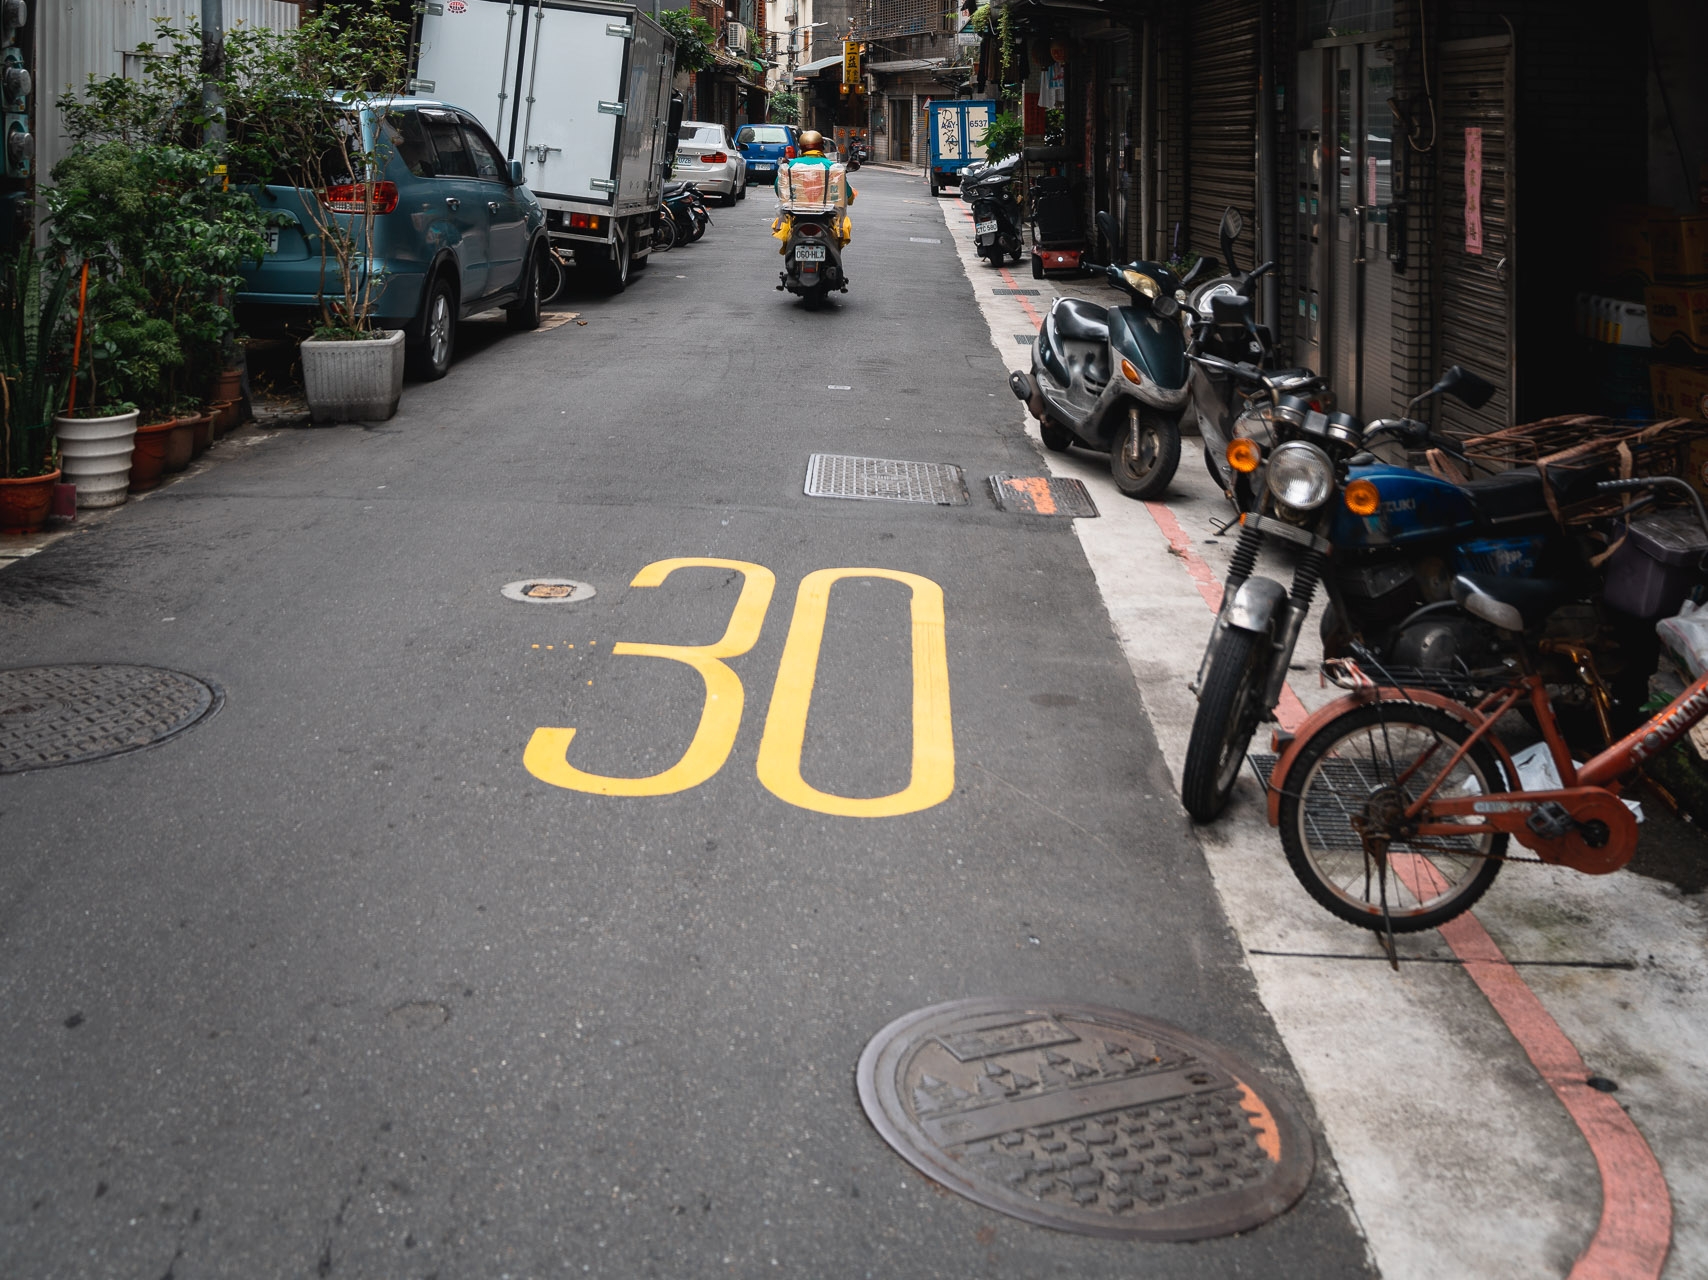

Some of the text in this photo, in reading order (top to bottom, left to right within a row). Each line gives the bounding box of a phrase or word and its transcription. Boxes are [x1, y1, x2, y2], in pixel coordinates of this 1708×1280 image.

[847, 43, 857, 68] 三益
[969, 120, 988, 128] 6537
[1379, 498, 1416, 513] ZUKI
[522, 557, 955, 818] 30
